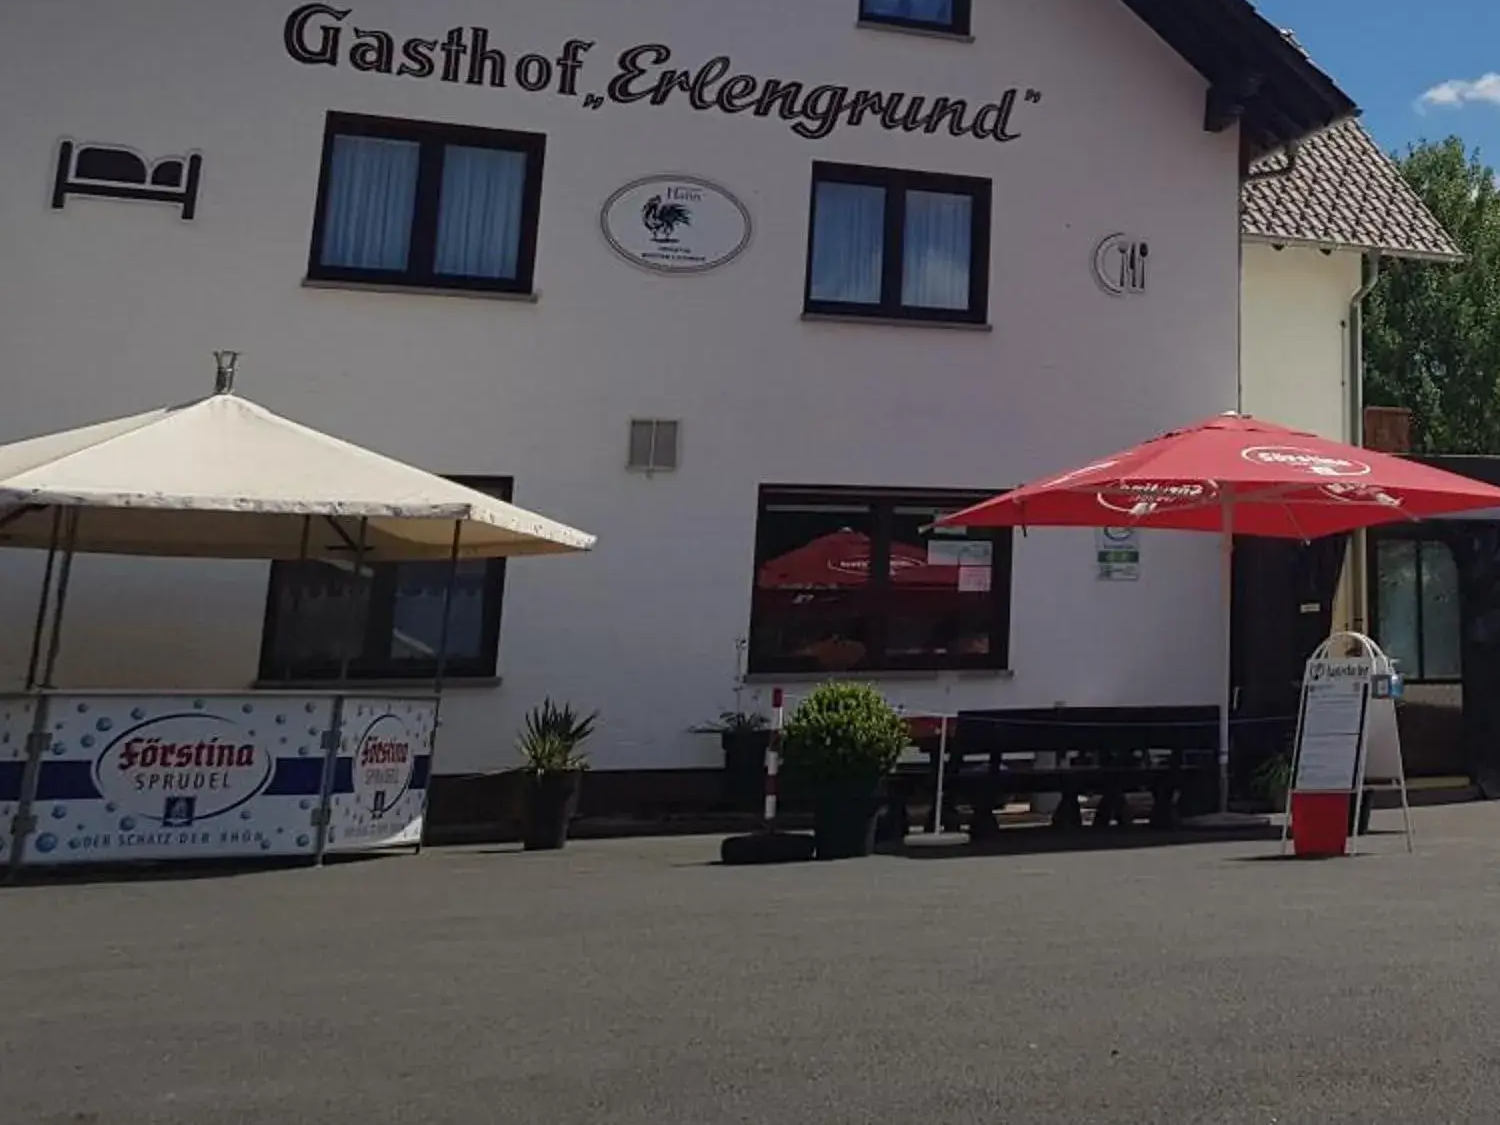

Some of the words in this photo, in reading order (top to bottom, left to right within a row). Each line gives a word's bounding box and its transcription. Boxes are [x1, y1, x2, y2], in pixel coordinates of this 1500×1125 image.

[283, 3, 597, 95] Gasthof
[118, 737, 254, 771] Förstina
[135, 771, 231, 791] SPRUDEL
